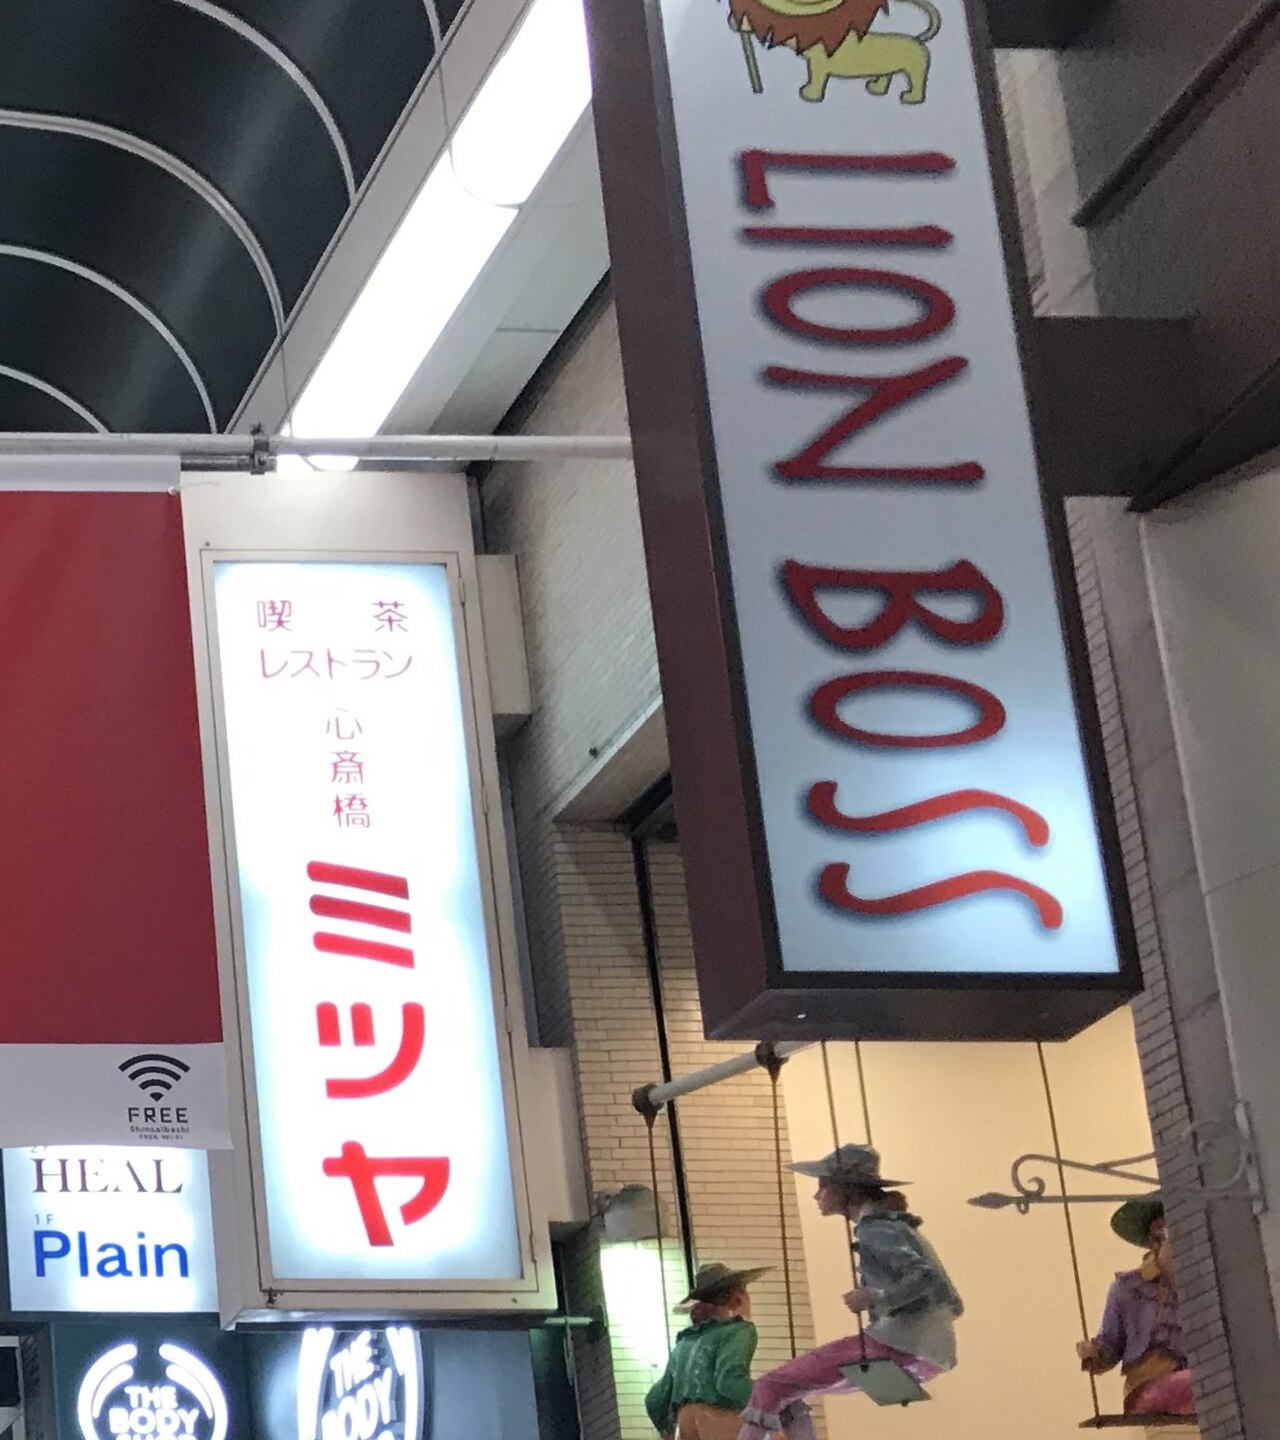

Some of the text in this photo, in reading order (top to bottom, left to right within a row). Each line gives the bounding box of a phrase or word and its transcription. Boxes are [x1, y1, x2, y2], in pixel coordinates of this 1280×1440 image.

[735, 150, 1064, 930] LION BOSS
[258, 648, 414, 682] レストラン
[306, 860, 451, 1248] ミツヤ
[128, 1107, 188, 1123] FREE
[30, 1158, 184, 1194] HEAL
[32, 1229, 190, 1279] Plain
[330, 1331, 376, 1386] THE
[125, 1385, 178, 1408] THE
[108, 1407, 200, 1435] BODY
